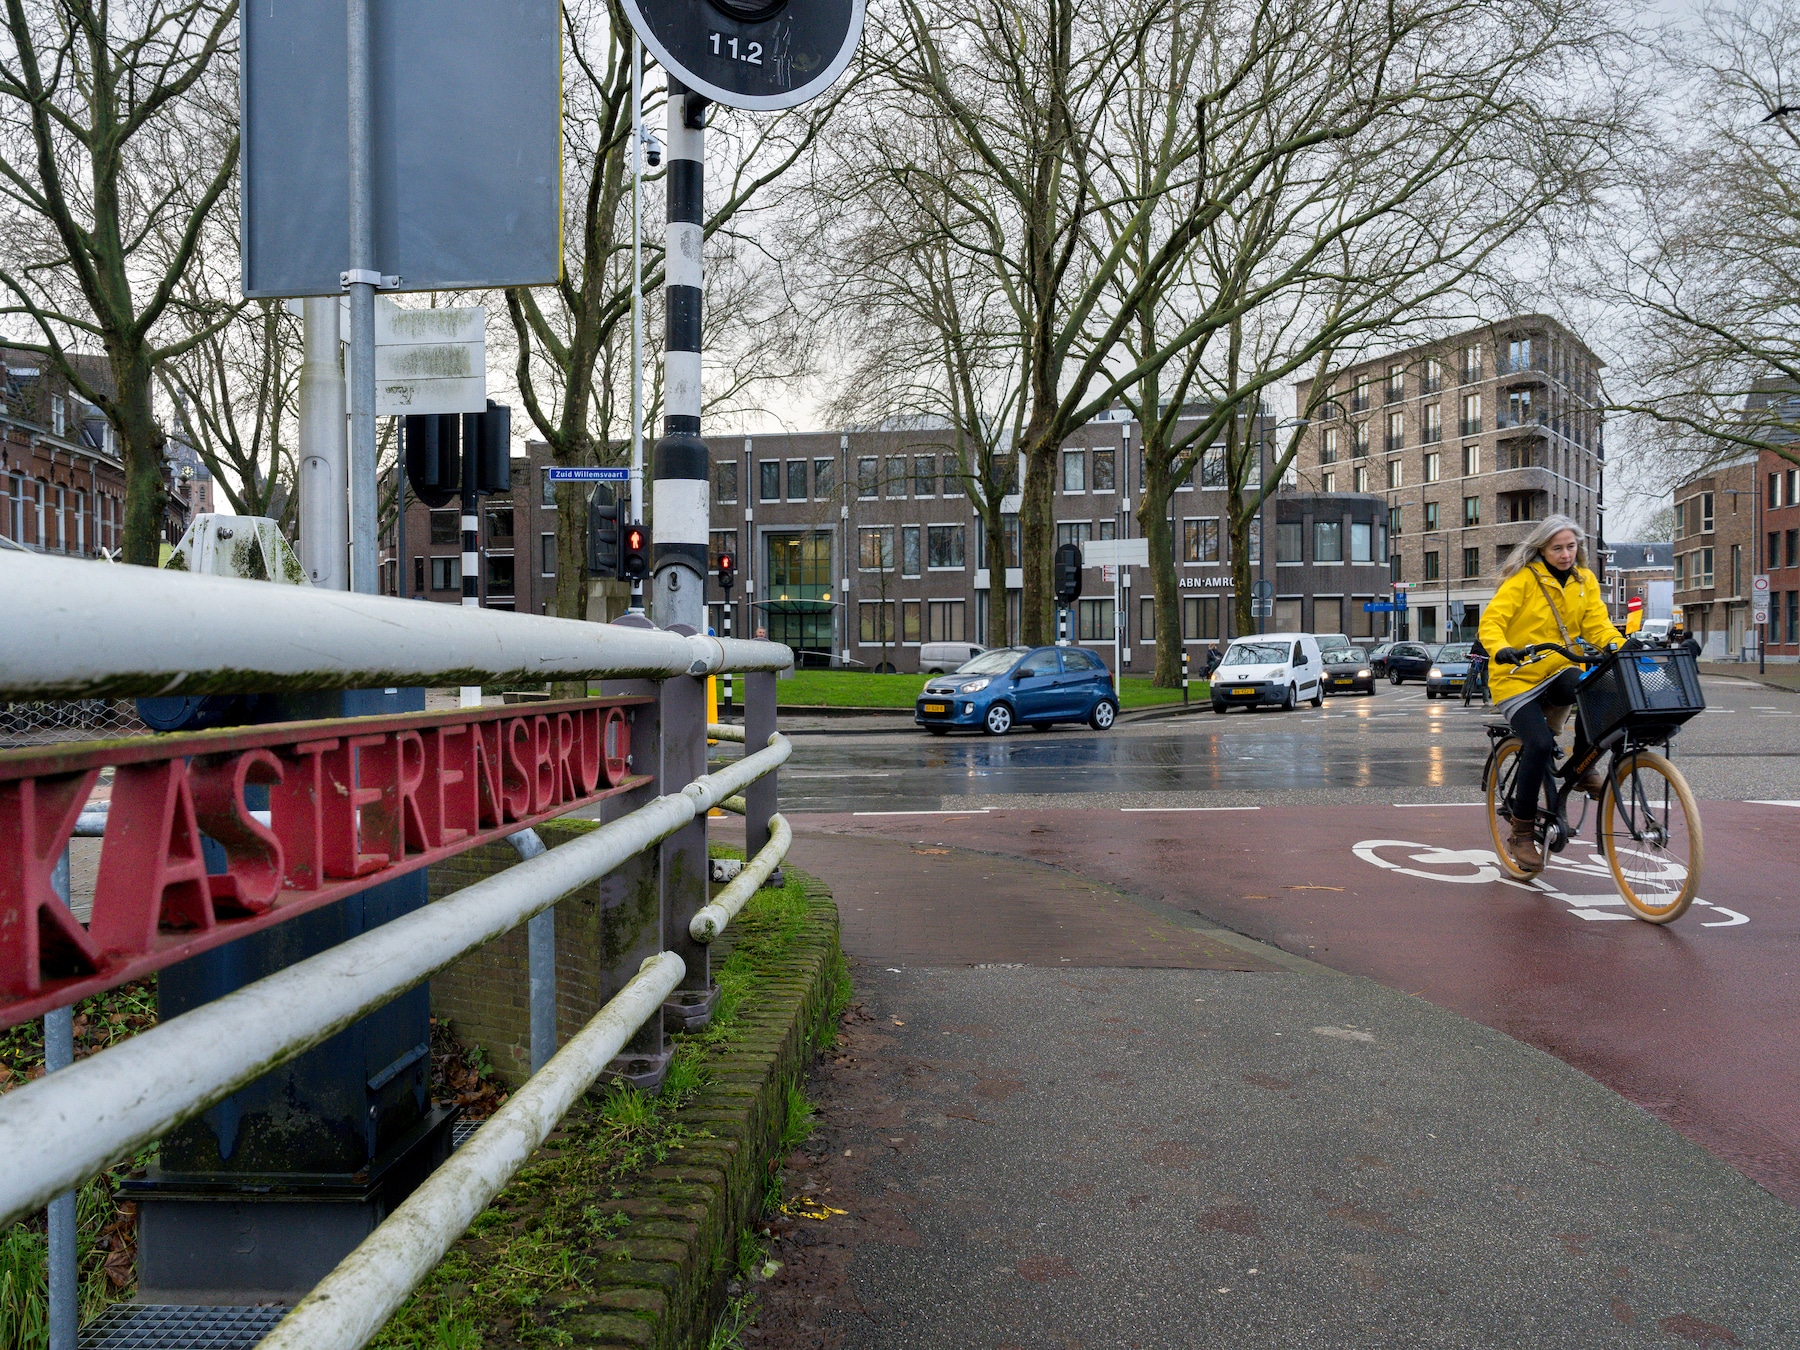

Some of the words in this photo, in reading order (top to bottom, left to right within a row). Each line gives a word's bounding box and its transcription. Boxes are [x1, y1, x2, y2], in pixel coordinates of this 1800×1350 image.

[709, 32, 763, 65] 11.2
[555, 470, 573, 478] Zuid
[573, 470, 623, 478] Willemsvaart
[16, 706, 627, 992] KASTERENSBRUG
